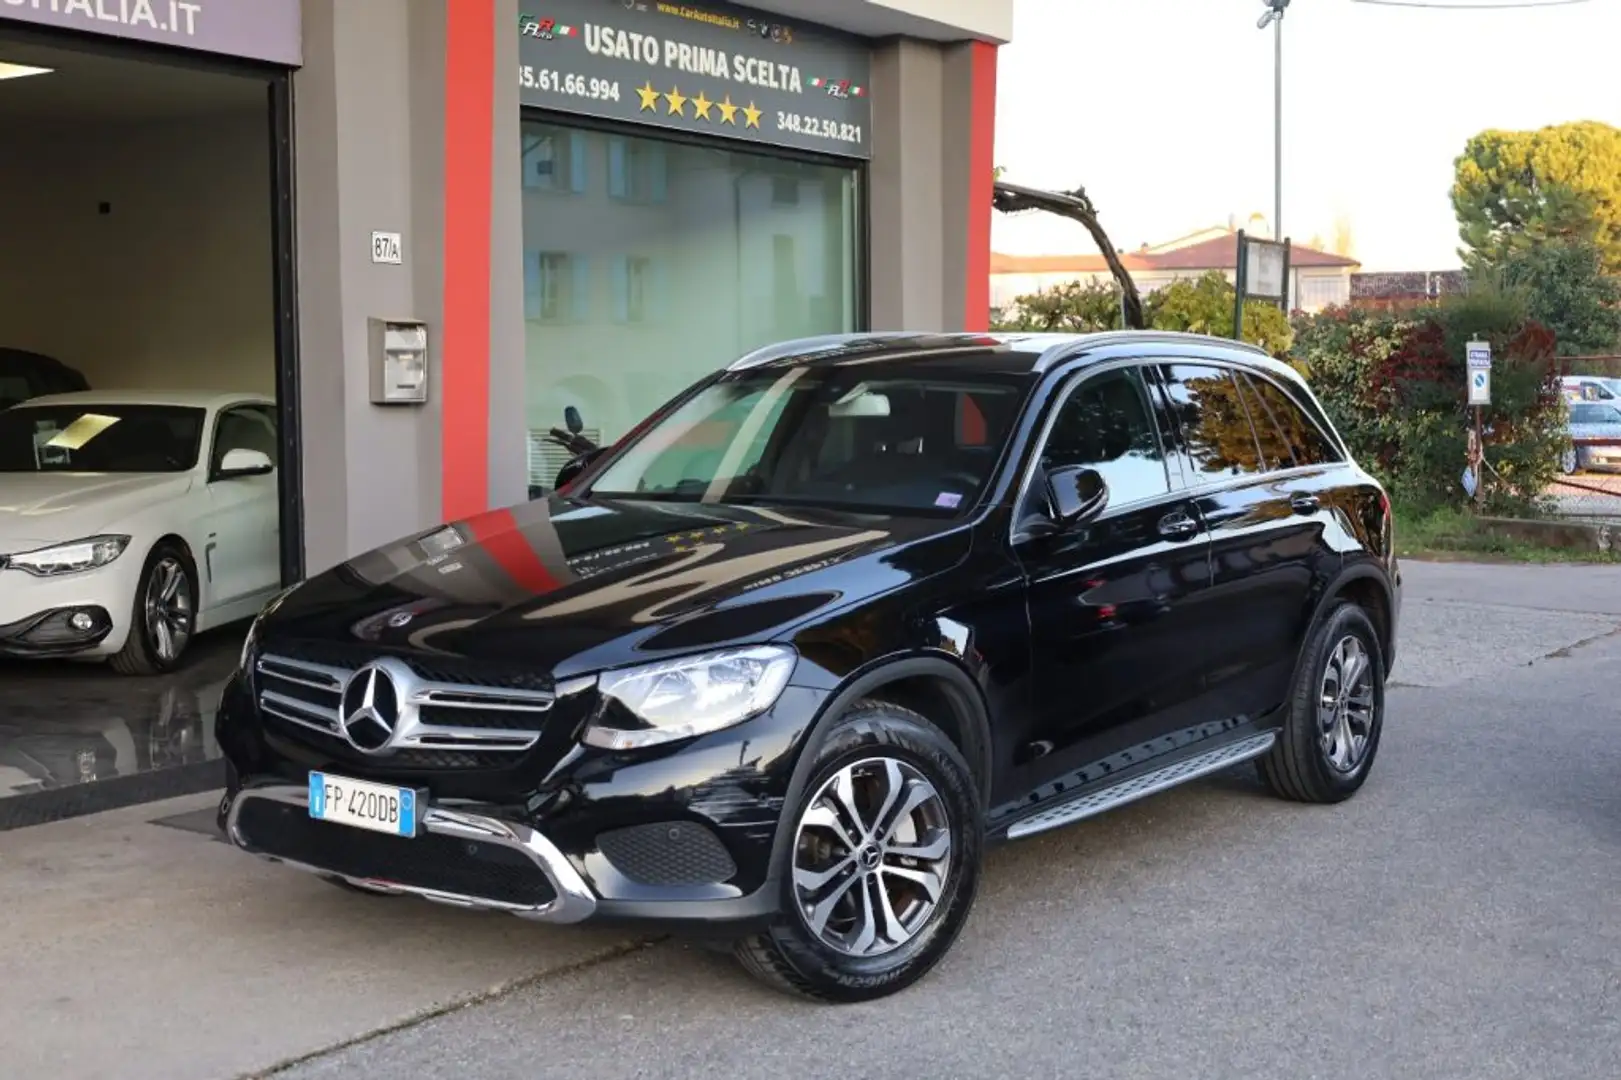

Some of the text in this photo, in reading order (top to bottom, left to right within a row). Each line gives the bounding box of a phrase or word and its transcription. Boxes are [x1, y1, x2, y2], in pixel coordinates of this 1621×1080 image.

[584, 23, 802, 94] USATO PRIMA SCELTA
[777, 111, 861, 143] 348.22.50.821
[375, 237, 398, 258] 87/A
[324, 784, 398, 823] FP 420DB
